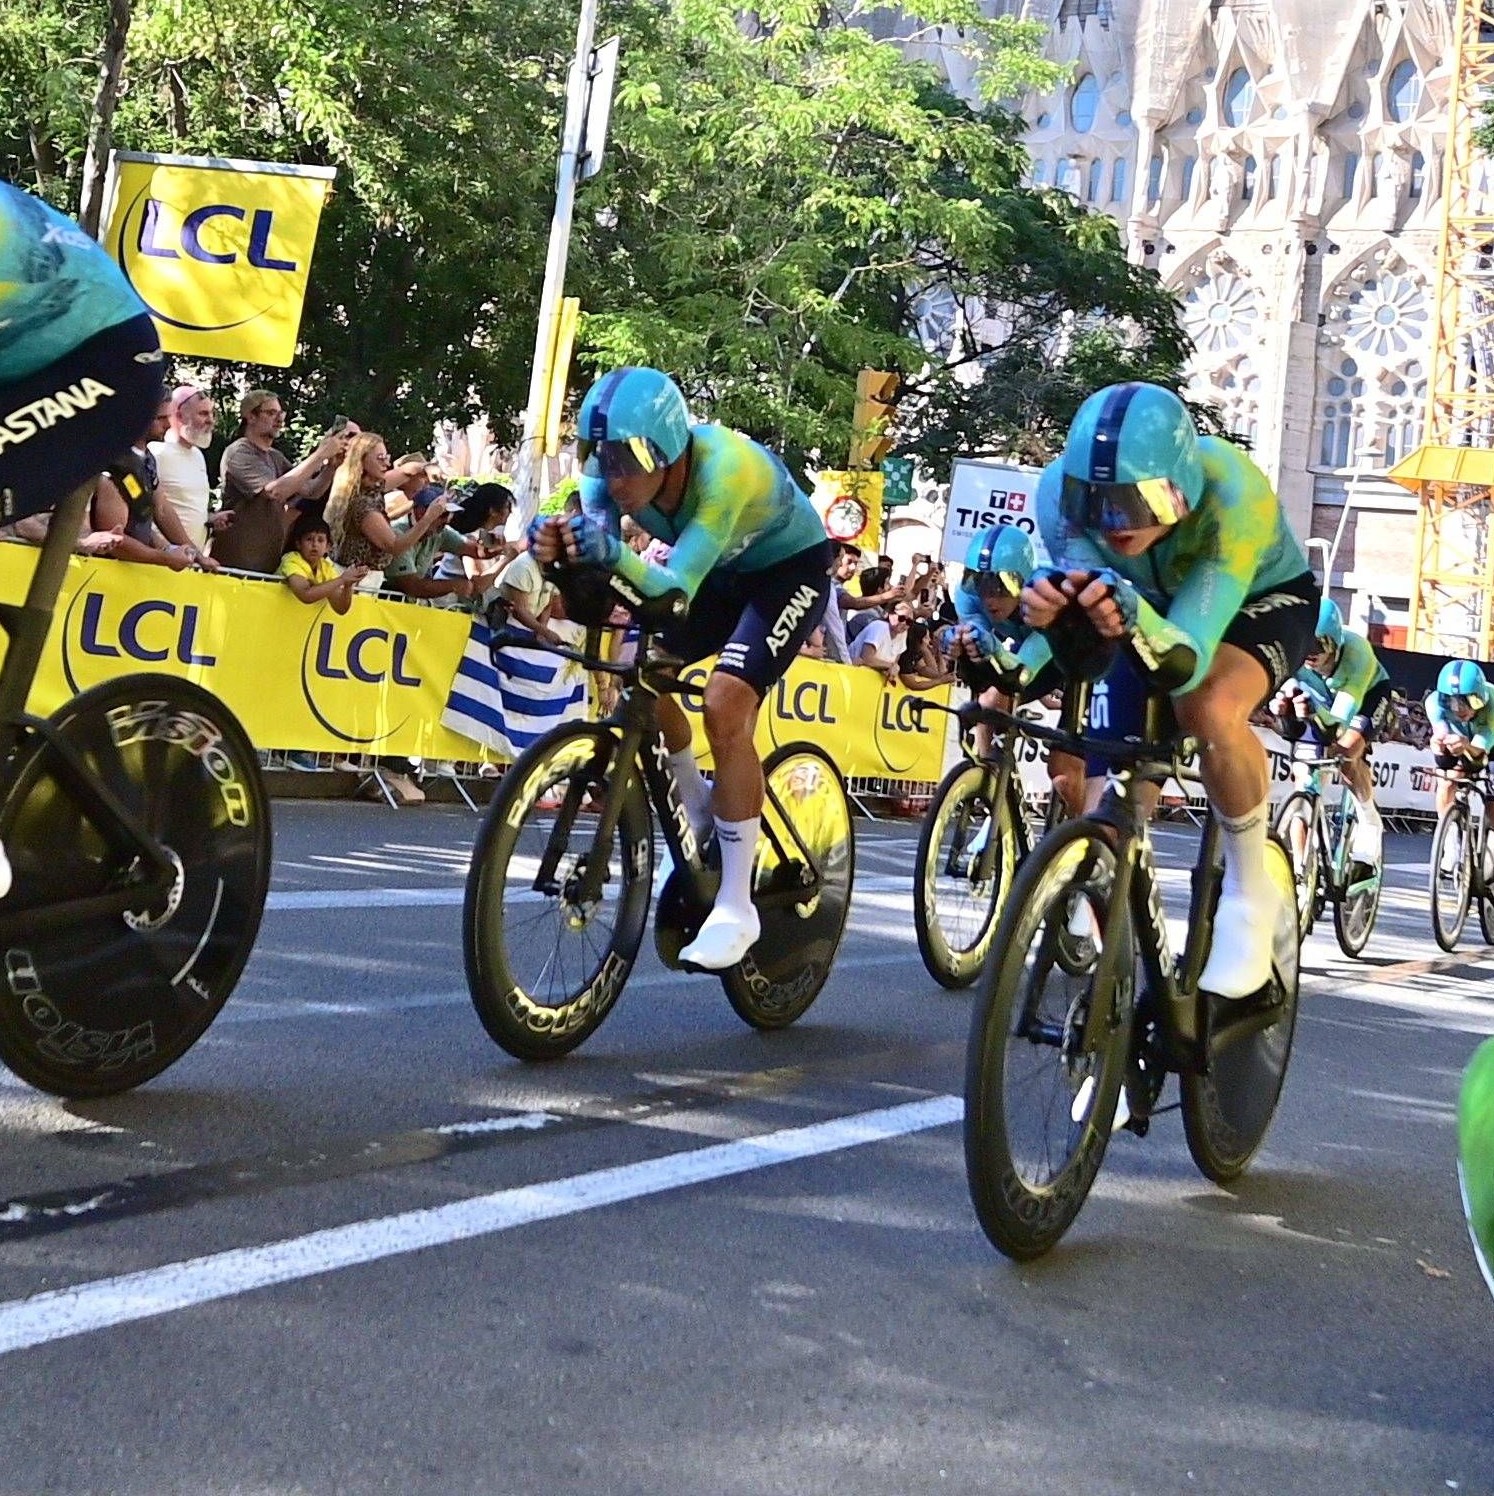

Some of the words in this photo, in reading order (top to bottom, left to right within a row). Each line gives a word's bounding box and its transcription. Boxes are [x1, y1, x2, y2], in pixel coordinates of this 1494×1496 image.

[140, 198, 297, 272] LCL
[956, 507, 1035, 535] TISSO
[80, 592, 216, 666] LCL
[315, 621, 421, 688] LCL
[765, 584, 820, 658] ASTANA
[777, 678, 835, 724] LCL
[881, 692, 929, 733] LCL
